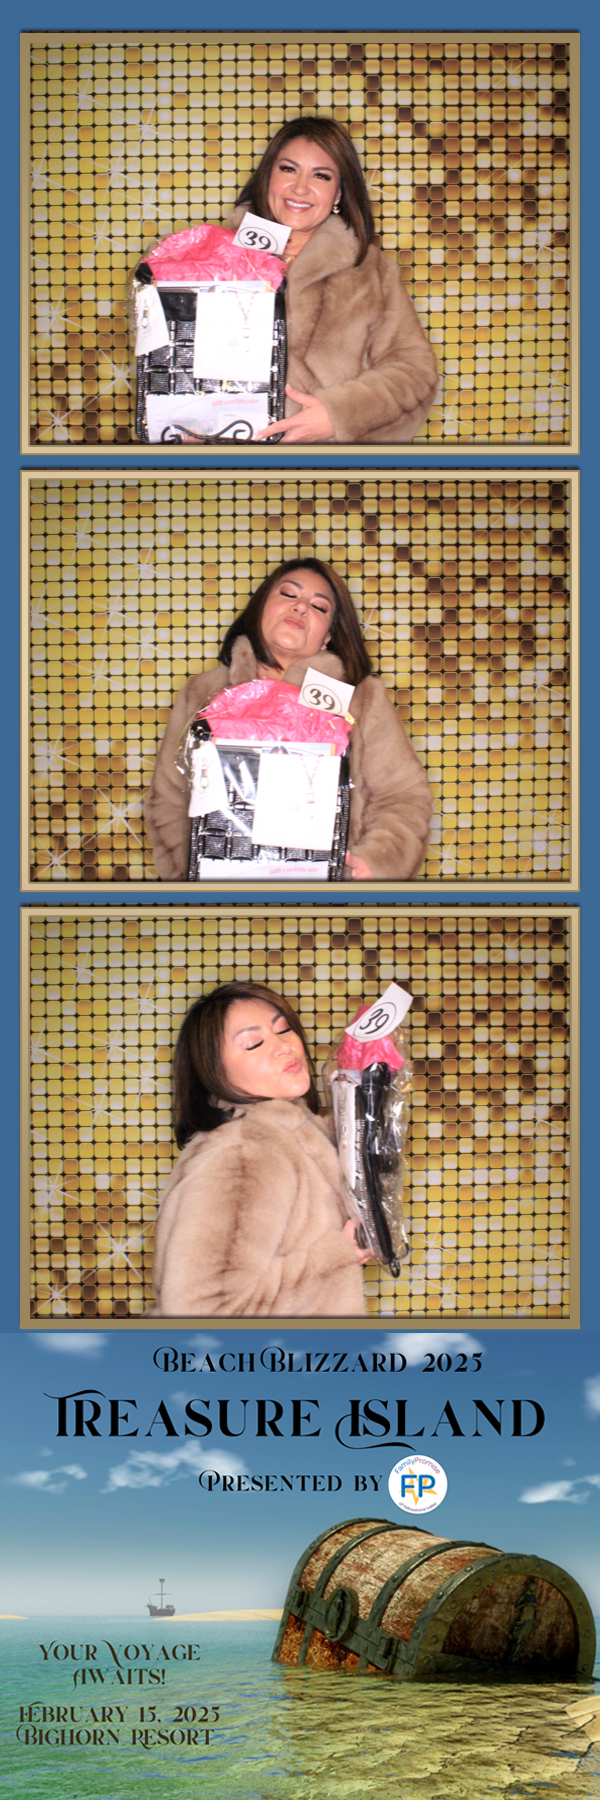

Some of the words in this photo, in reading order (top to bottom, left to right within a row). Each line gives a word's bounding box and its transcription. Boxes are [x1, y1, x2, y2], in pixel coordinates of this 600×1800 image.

[244, 230, 272, 251] 39
[212, 399, 224, 407] gift
[310, 688, 336, 710] 39
[359, 1008, 390, 1035] 39
